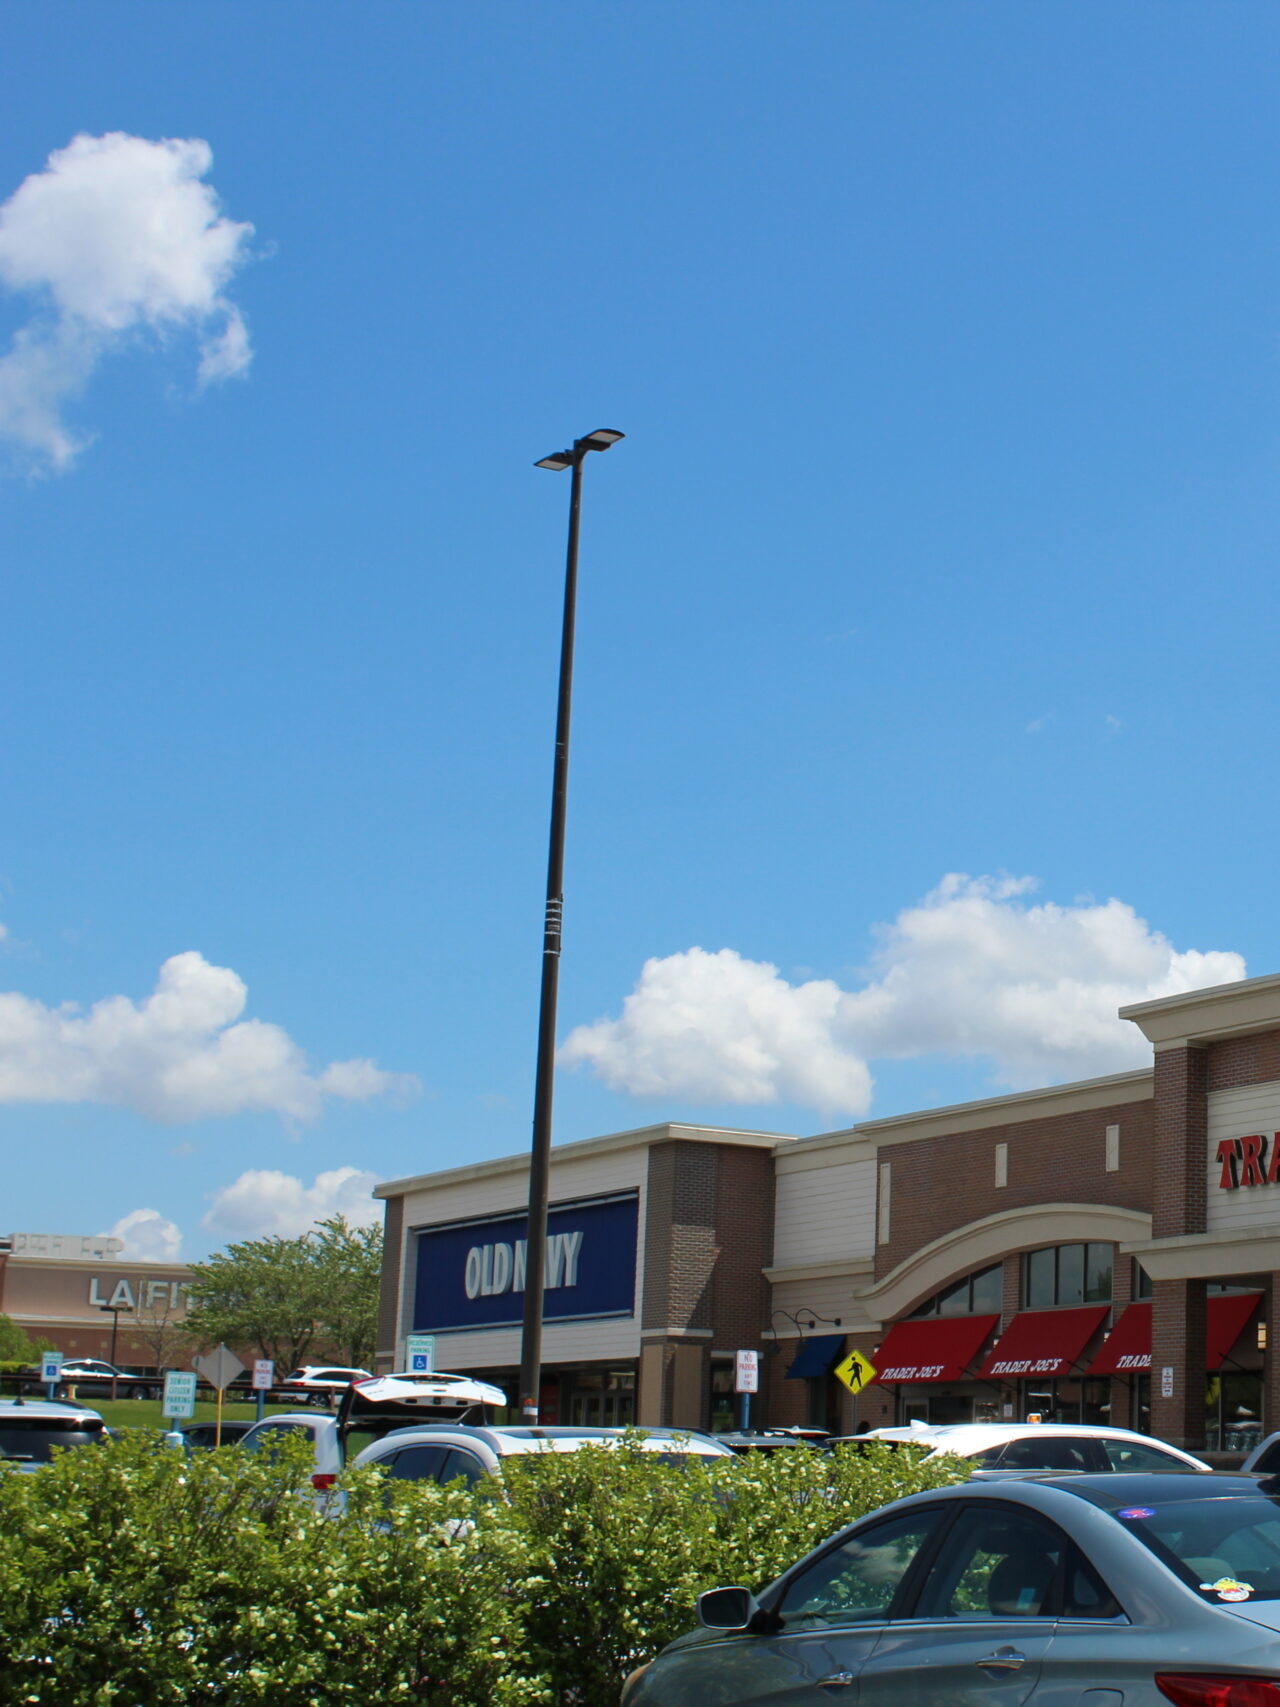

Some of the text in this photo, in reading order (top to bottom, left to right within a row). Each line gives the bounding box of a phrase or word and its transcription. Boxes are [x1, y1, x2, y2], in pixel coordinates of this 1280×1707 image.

[465, 1231, 584, 1300] OLD NVY
[89, 1278, 136, 1306] LA
[744, 1353, 753, 1363] NO
[880, 1365, 944, 1380] TRADER JOE'S
[990, 1358, 1063, 1375] TRADER JOE'S
[169, 1386, 191, 1394] CITIZEN
